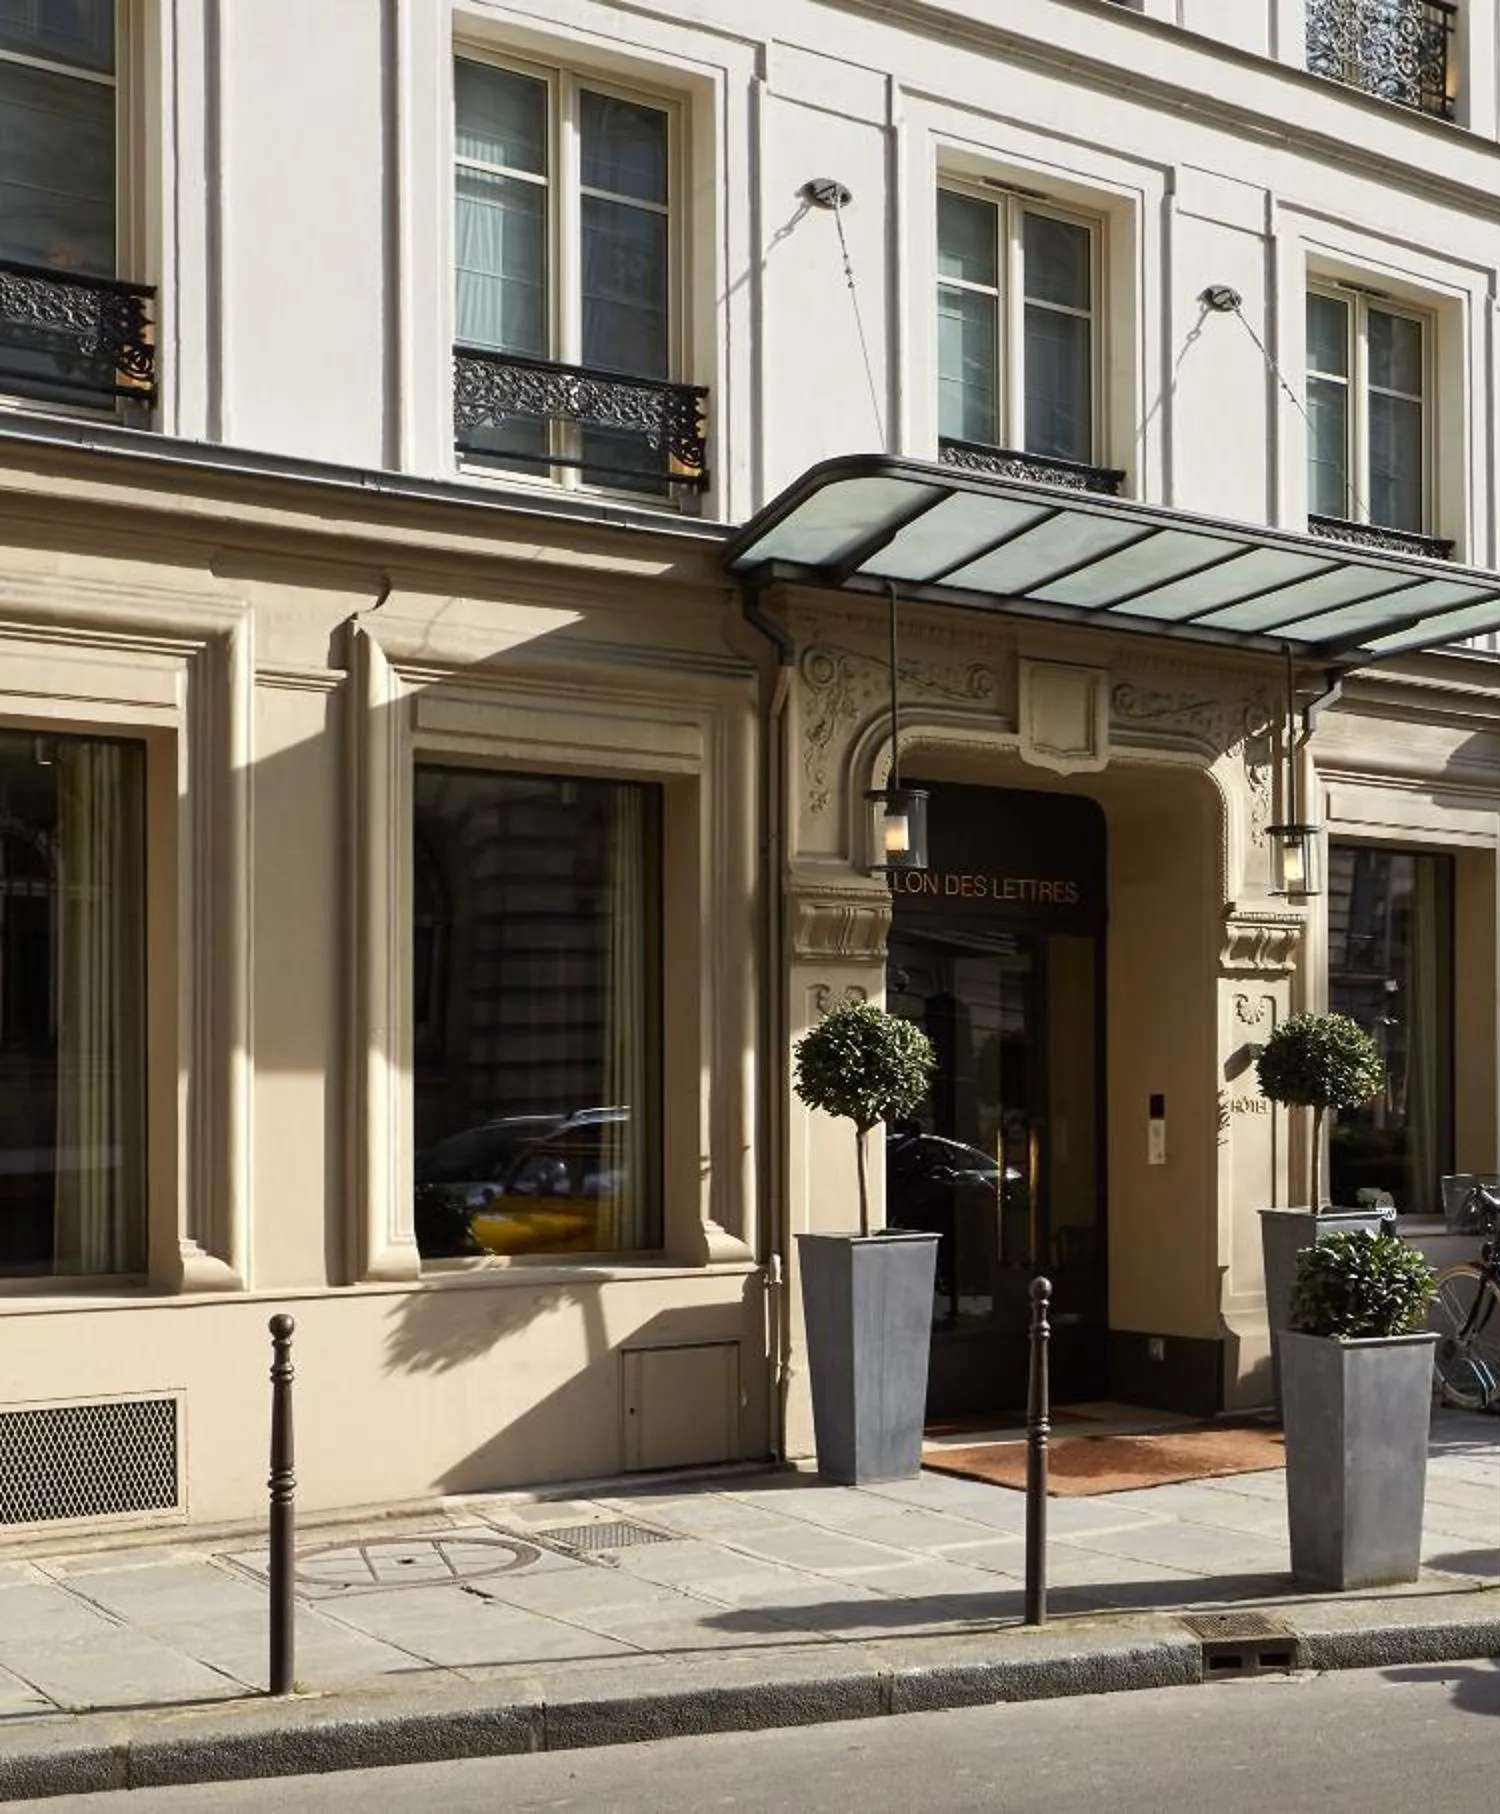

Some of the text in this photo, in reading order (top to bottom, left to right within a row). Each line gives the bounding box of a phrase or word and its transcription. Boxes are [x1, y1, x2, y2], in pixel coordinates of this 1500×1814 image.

[890, 871, 1079, 904] LON DES LETTRES
